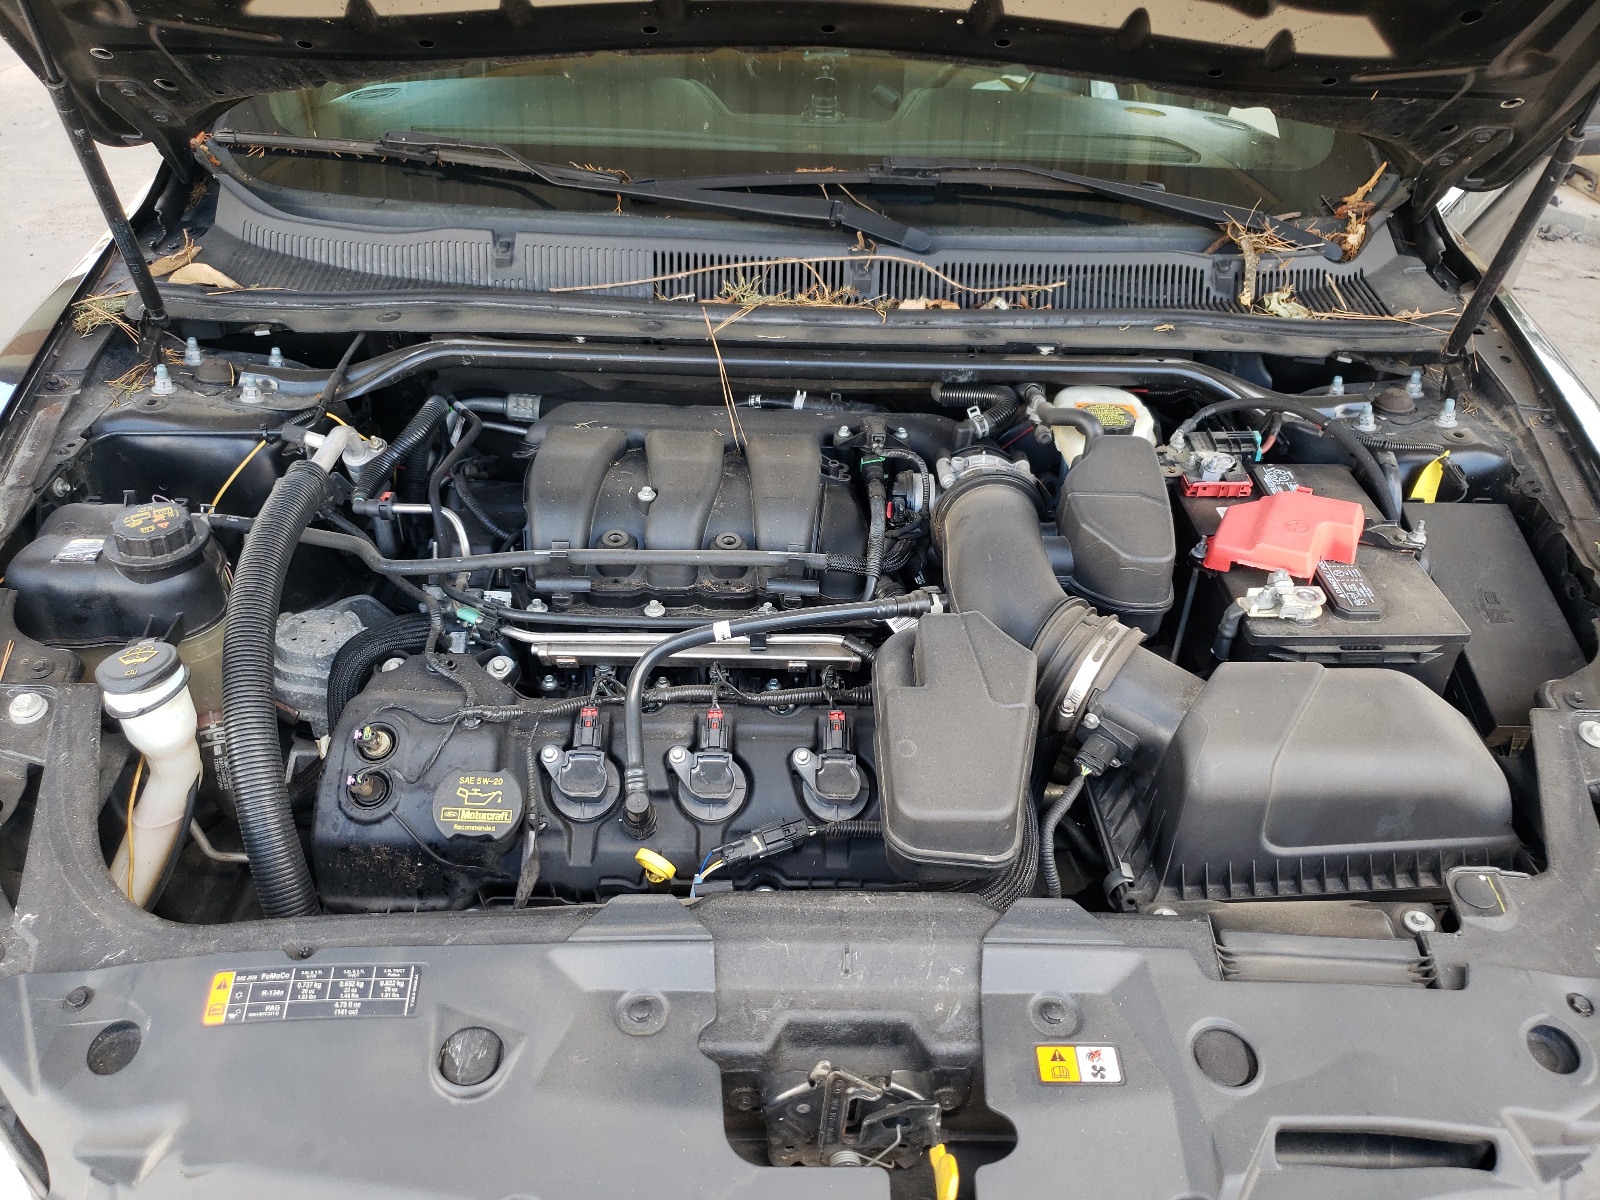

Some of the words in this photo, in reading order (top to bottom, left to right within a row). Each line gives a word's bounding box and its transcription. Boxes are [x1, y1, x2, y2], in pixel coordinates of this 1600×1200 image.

[477, 778, 504, 786] 5W-20
[261, 972, 290, 980] FoMoCo
[397, 980, 404, 988] kg
